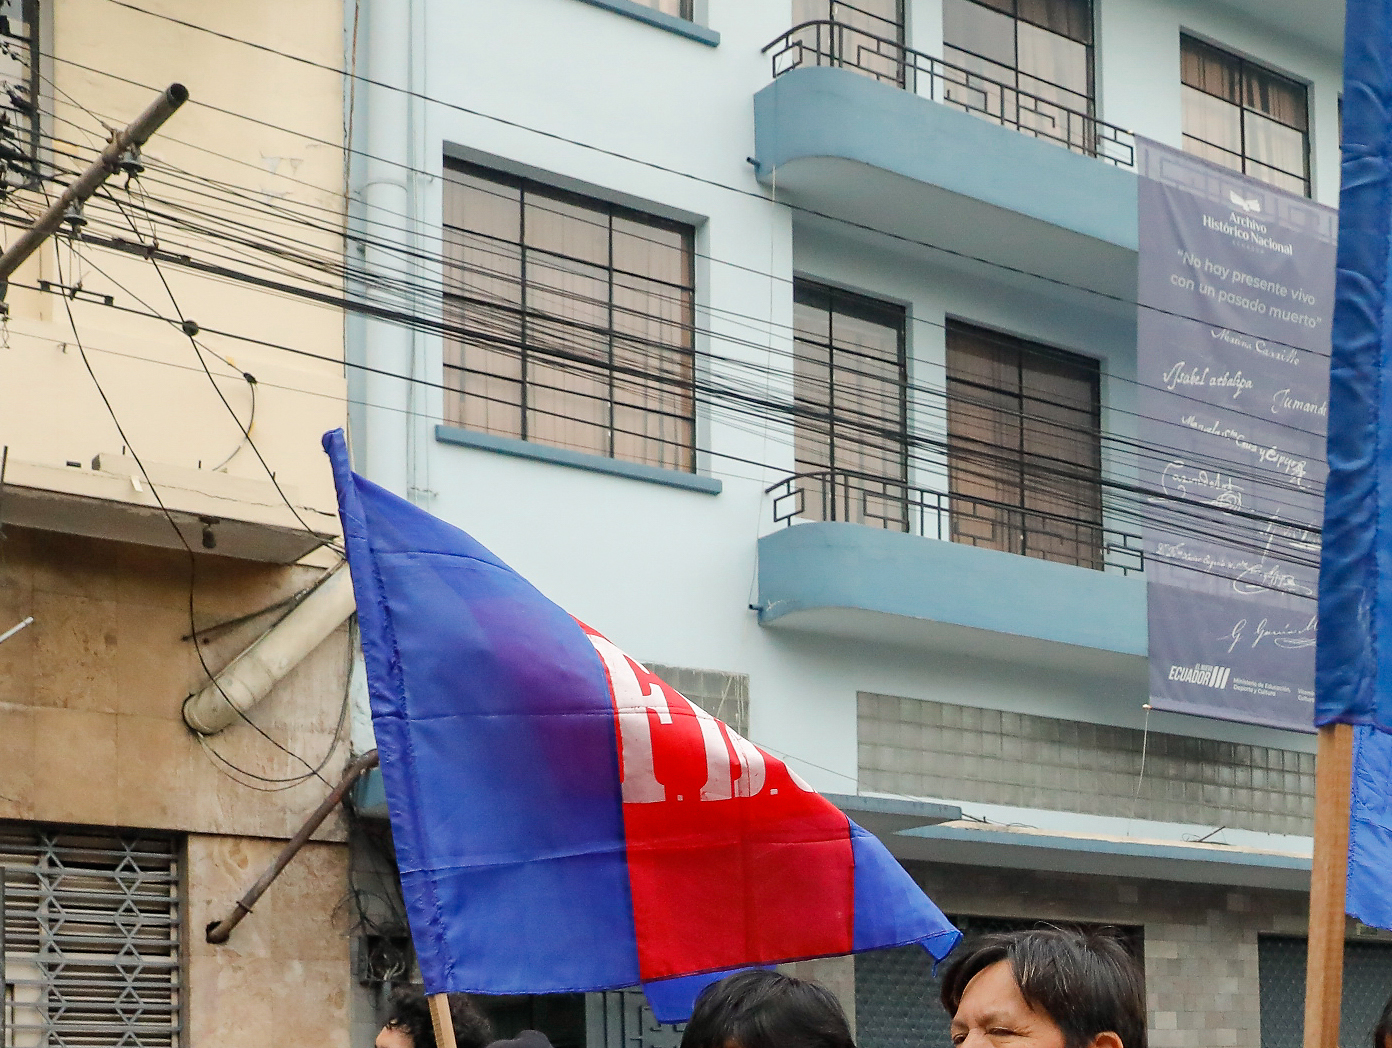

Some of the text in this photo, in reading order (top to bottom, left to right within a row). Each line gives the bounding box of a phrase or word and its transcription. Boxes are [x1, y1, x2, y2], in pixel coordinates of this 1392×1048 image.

[1203, 214, 1249, 242] Histórico
[1250, 231, 1293, 256] Nacional
[1229, 211, 1267, 235] Archivo
[1170, 273, 1195, 291] con
[1199, 283, 1215, 298] un
[1218, 288, 1267, 314] pasado
[1204, 259, 1230, 281] hay
[1232, 269, 1288, 297] presente
[1292, 287, 1316, 305] vivo
[1168, 665, 1212, 686] ECUADOR
